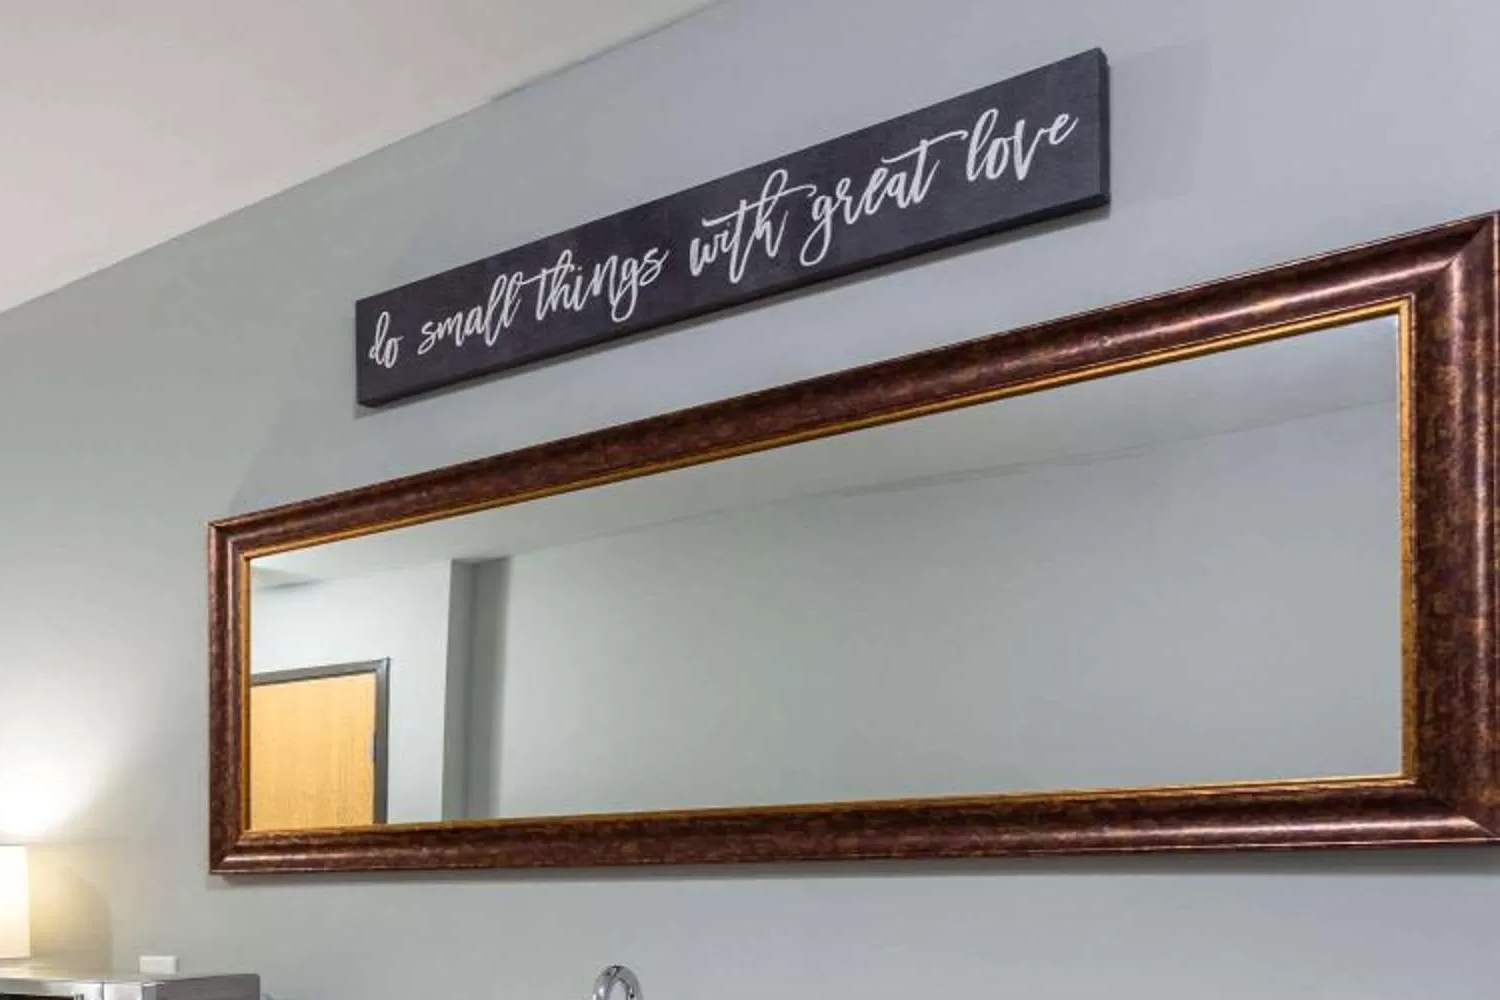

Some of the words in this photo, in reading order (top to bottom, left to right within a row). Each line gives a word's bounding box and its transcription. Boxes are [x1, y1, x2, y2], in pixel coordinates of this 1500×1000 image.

[368, 311, 405, 369] do
[417, 271, 529, 355] small
[526, 249, 669, 323] things
[689, 169, 817, 283] with
[800, 129, 969, 267] great
[965, 108, 1079, 182] love
